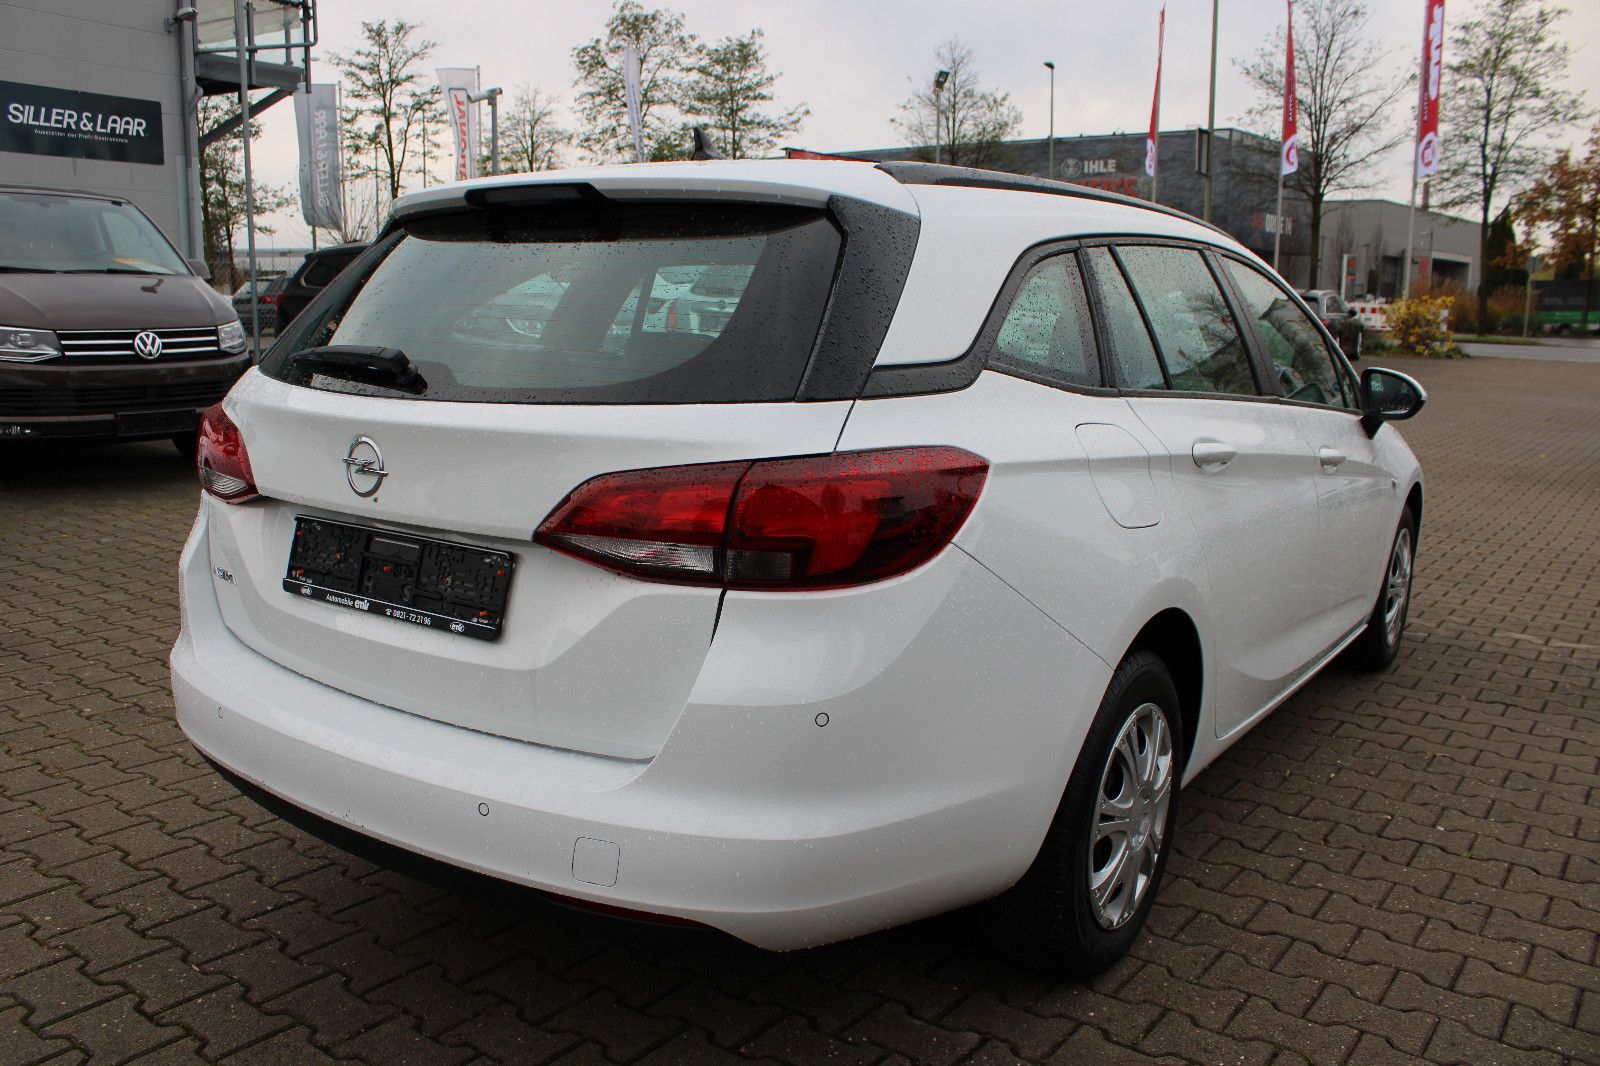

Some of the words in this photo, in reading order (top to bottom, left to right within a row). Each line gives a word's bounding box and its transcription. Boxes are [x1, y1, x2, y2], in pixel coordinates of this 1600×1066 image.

[7, 103, 78, 130] SILLER
[79, 112, 94, 132] &
[96, 113, 147, 137] LAAR
[1084, 159, 1117, 174] IHLE
[325, 593, 354, 607] Automobile
[354, 599, 370, 611] emir
